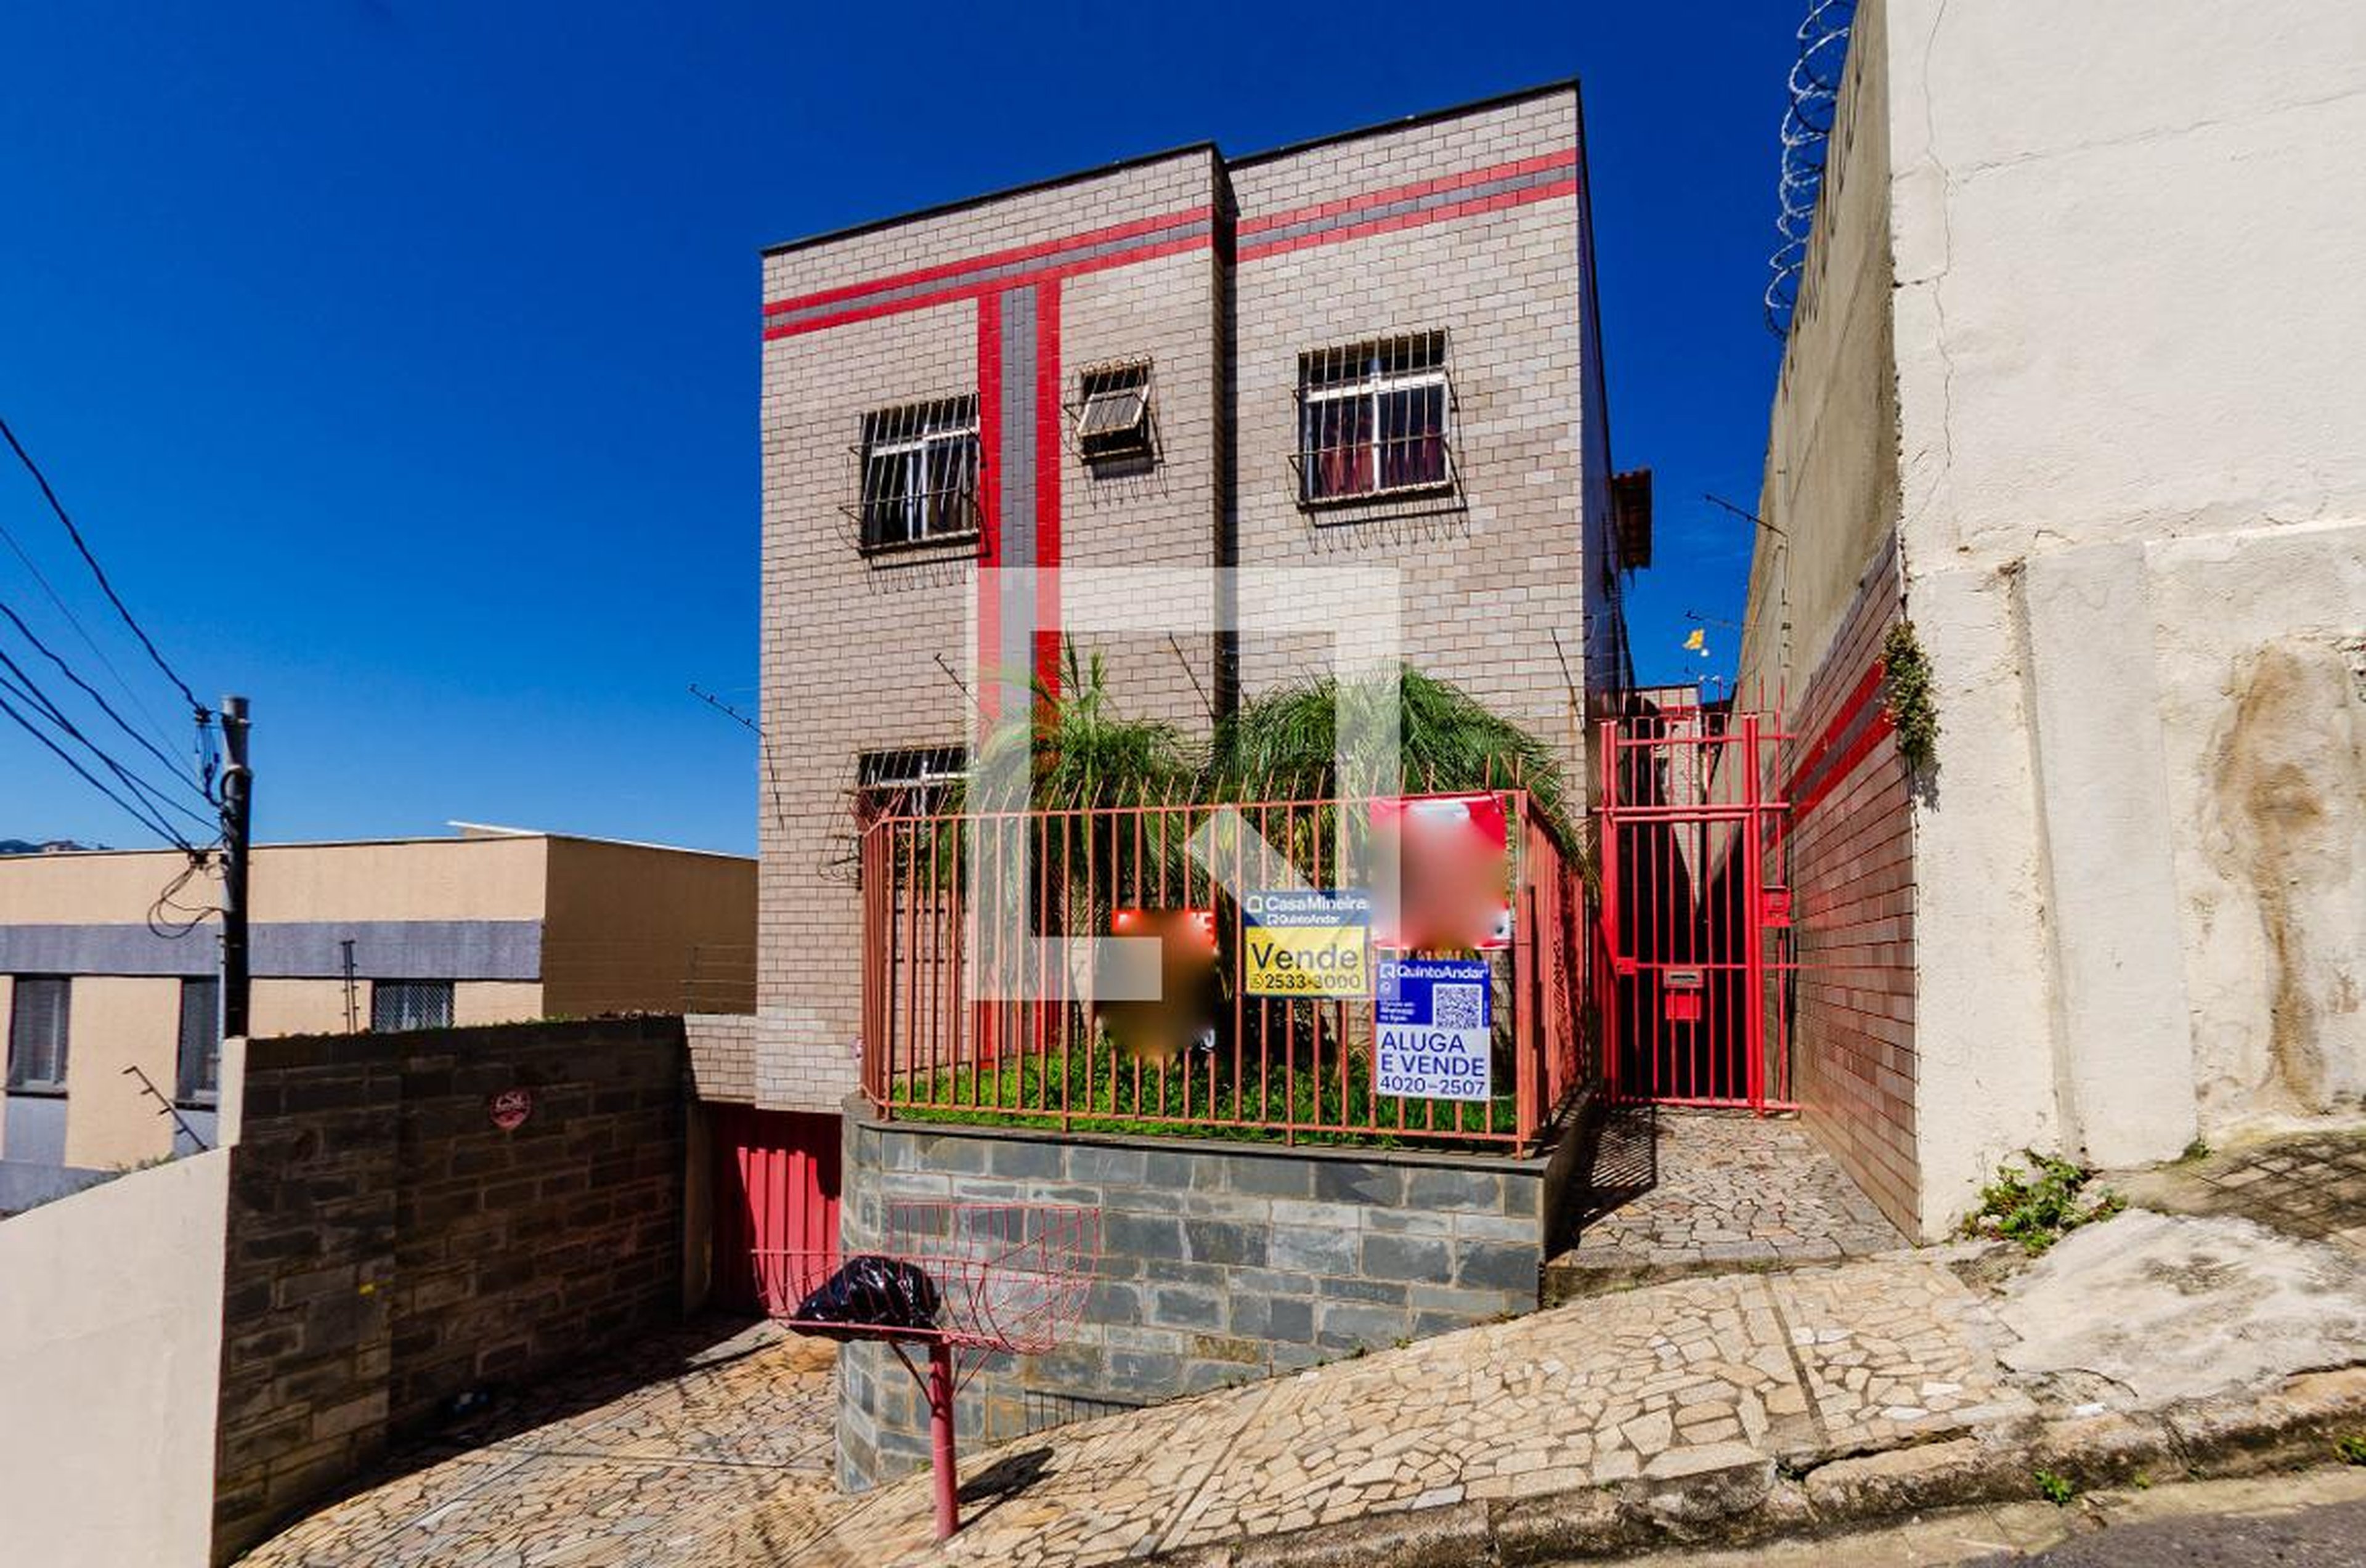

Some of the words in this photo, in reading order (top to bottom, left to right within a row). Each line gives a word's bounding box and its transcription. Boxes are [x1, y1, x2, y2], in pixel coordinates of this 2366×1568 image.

[1251, 943, 1358, 970] Vende
[1397, 965, 1484, 978] QuintoAndar
[1381, 1031, 1466, 1053] ALUGA
[1381, 1054, 1393, 1072] E
[1400, 1055, 1484, 1076] VENDE
[1380, 1076, 1485, 1095] 4020-2507
